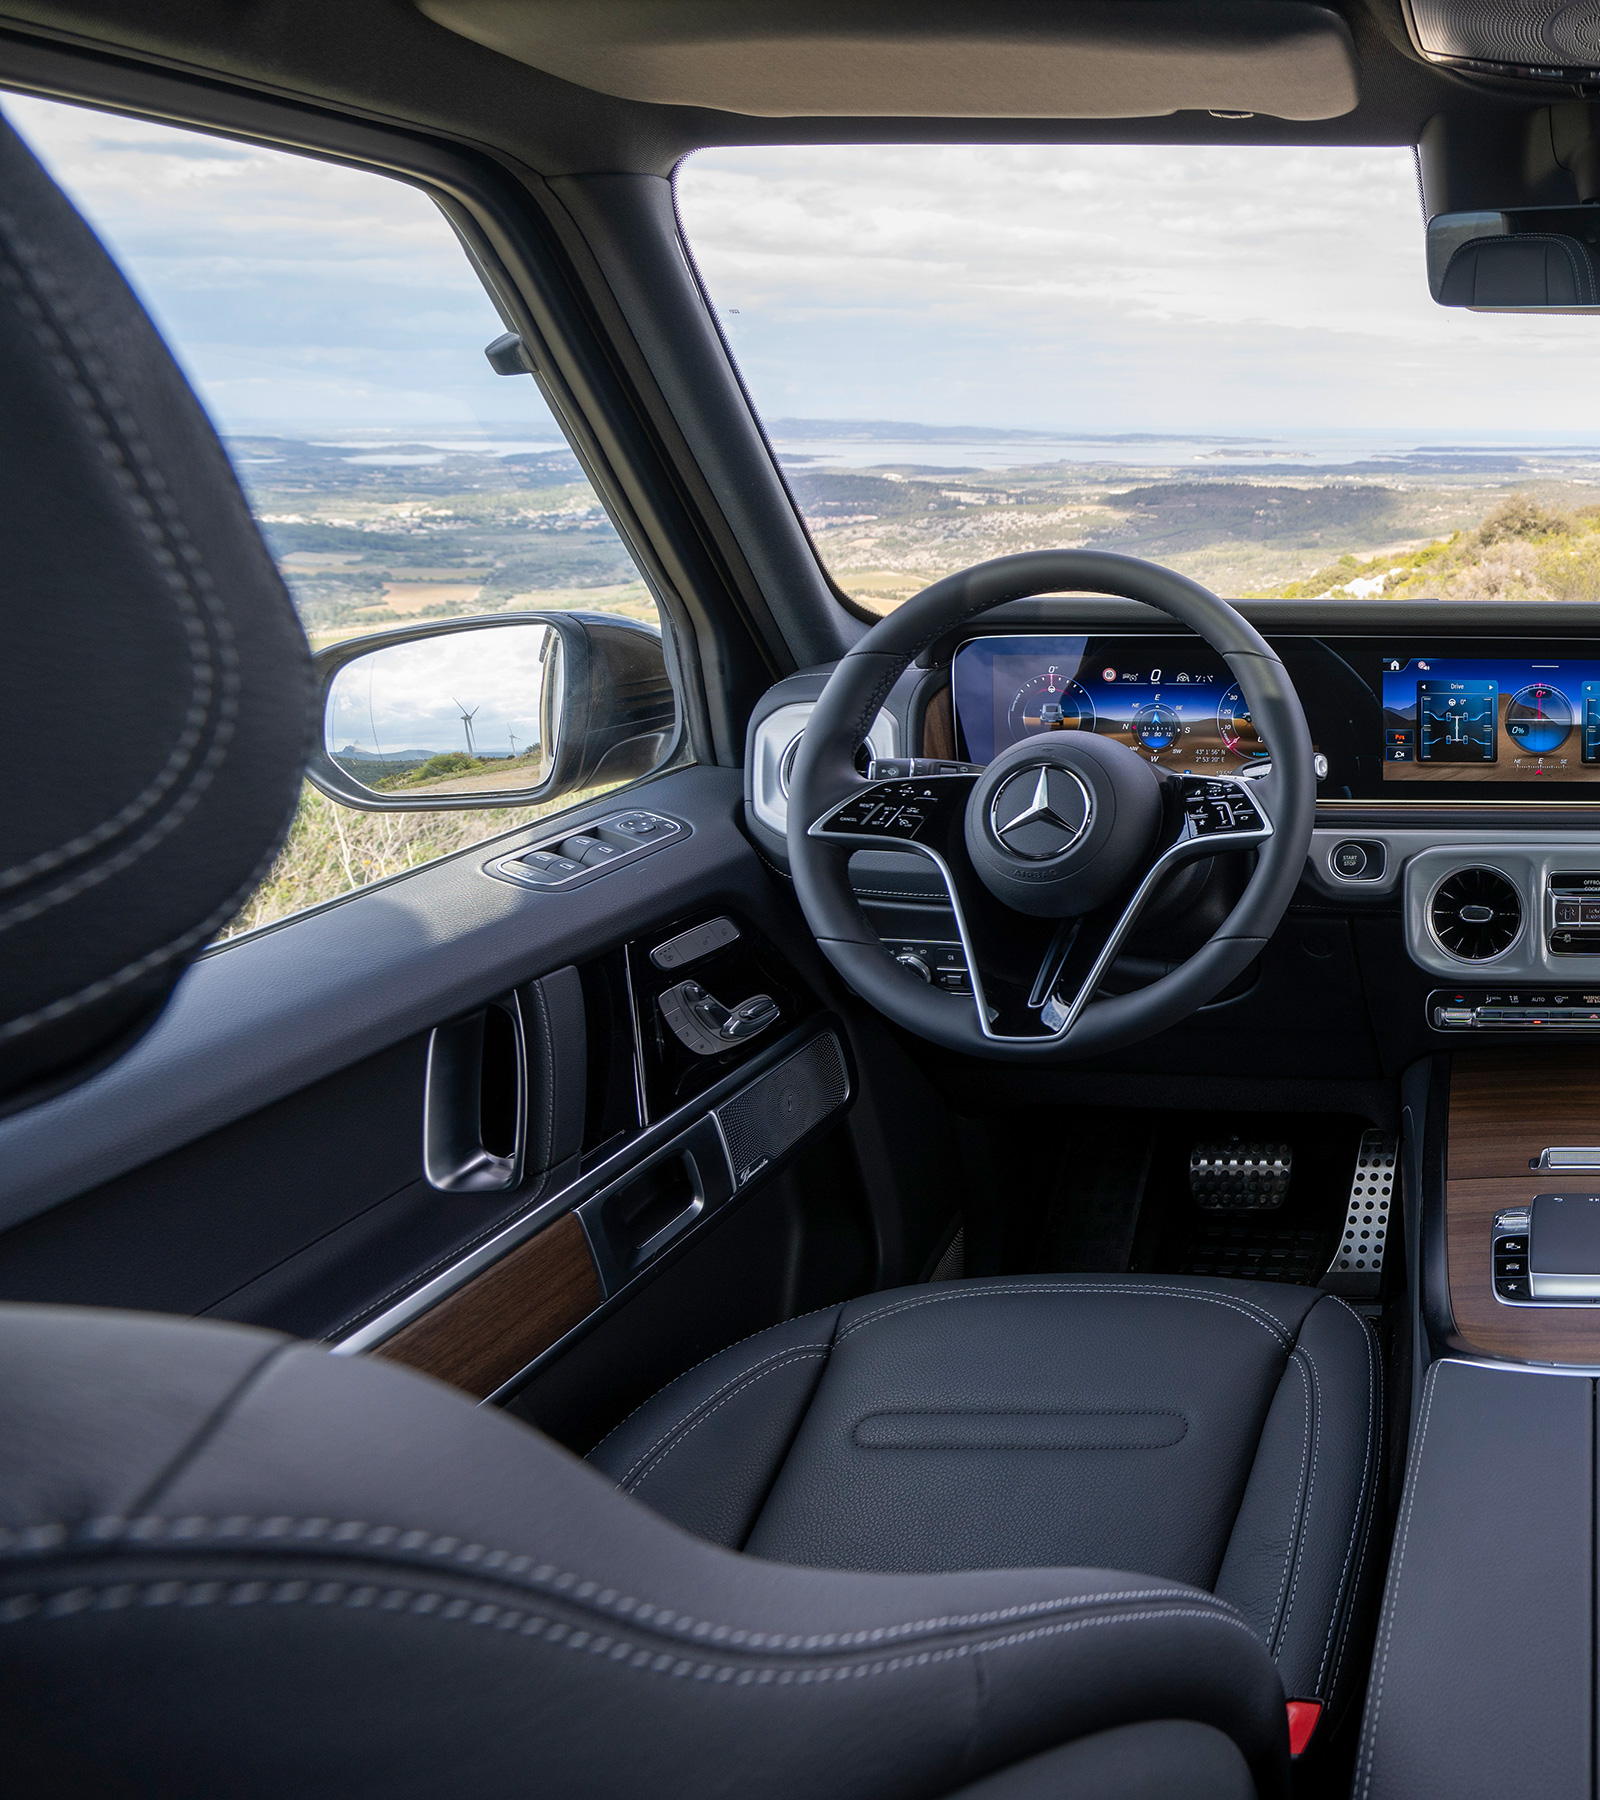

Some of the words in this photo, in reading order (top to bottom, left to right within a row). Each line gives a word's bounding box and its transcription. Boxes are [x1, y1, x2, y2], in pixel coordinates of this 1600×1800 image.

[1150, 669, 1162, 681] 0
[1512, 726, 1525, 734] 0%
[1013, 870, 1057, 878] AIRBAG
